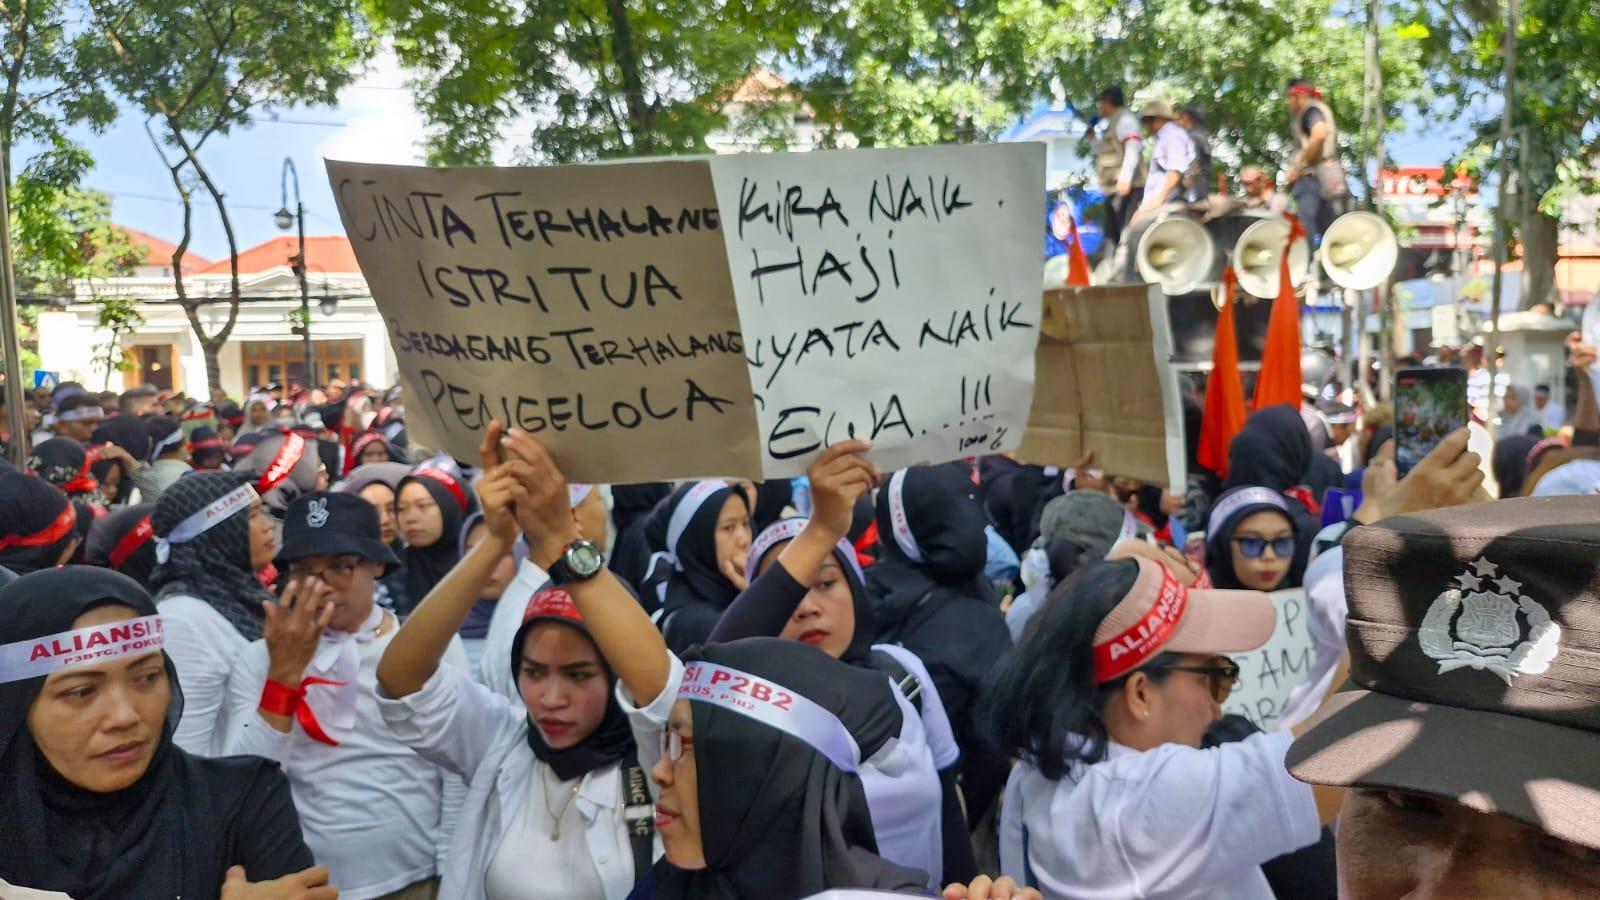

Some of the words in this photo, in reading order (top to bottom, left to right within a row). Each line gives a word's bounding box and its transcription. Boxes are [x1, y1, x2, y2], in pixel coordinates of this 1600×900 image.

[417, 260, 549, 313] ISTRI
[547, 265, 682, 312] TUA
[549, 327, 743, 370] TERHALANG
[420, 369, 735, 434] PENGELOLA
[29, 621, 150, 663] ALIANSI
[1110, 580, 1178, 661] ALIANSI
[710, 669, 794, 712] P2B2
